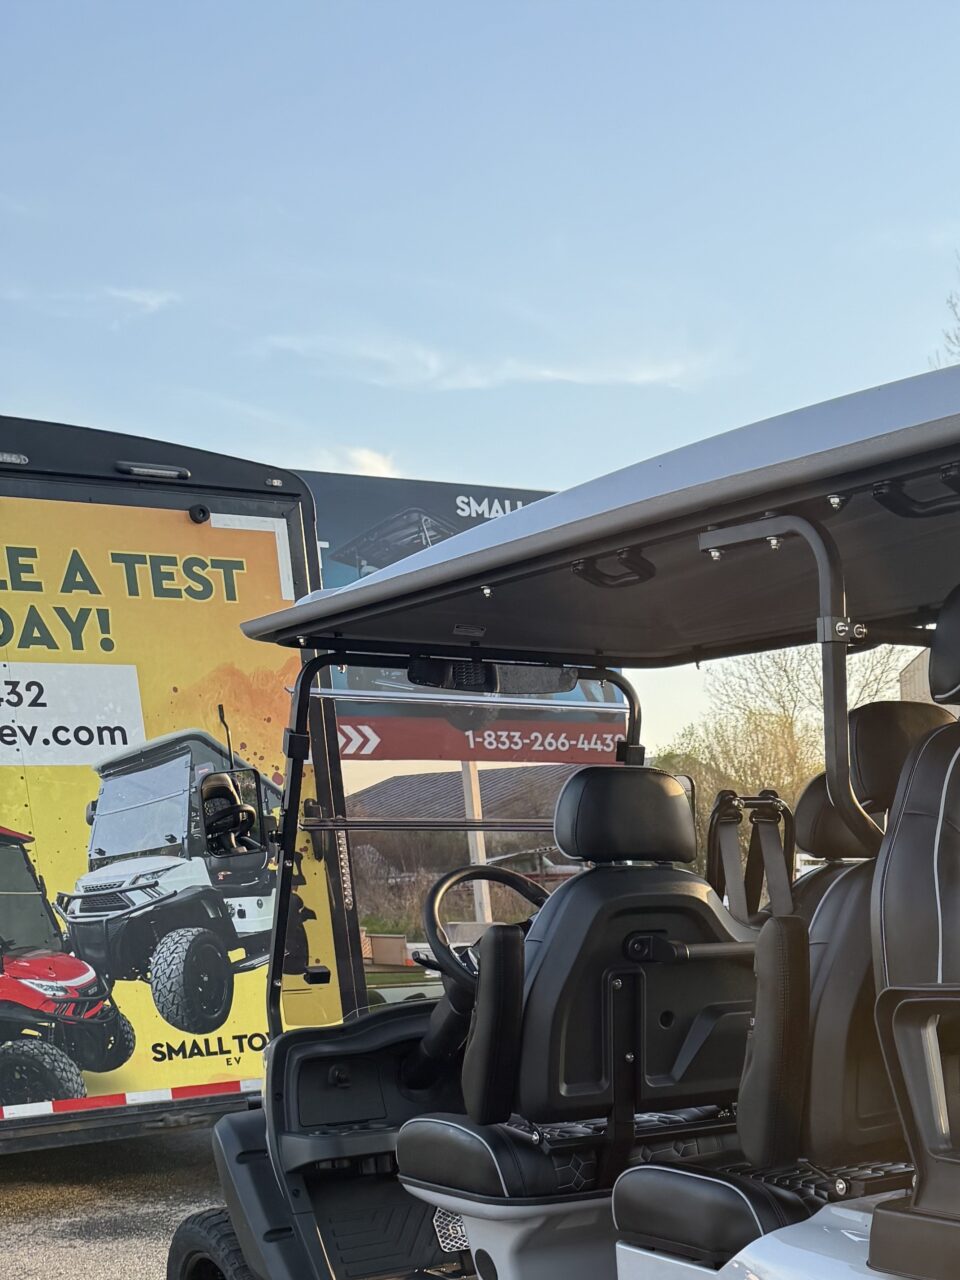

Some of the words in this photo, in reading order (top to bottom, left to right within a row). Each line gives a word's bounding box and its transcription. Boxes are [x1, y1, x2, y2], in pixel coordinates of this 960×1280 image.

[0, 546, 43, 592] E
[60, 549, 102, 595] A
[110, 552, 245, 602] TEST
[0, 680, 47, 707] 32
[0, 725, 128, 746] ev.com
[151, 1036, 231, 1062] SMALL
[232, 1032, 270, 1052] TO
[226, 1057, 241, 1066] EV
